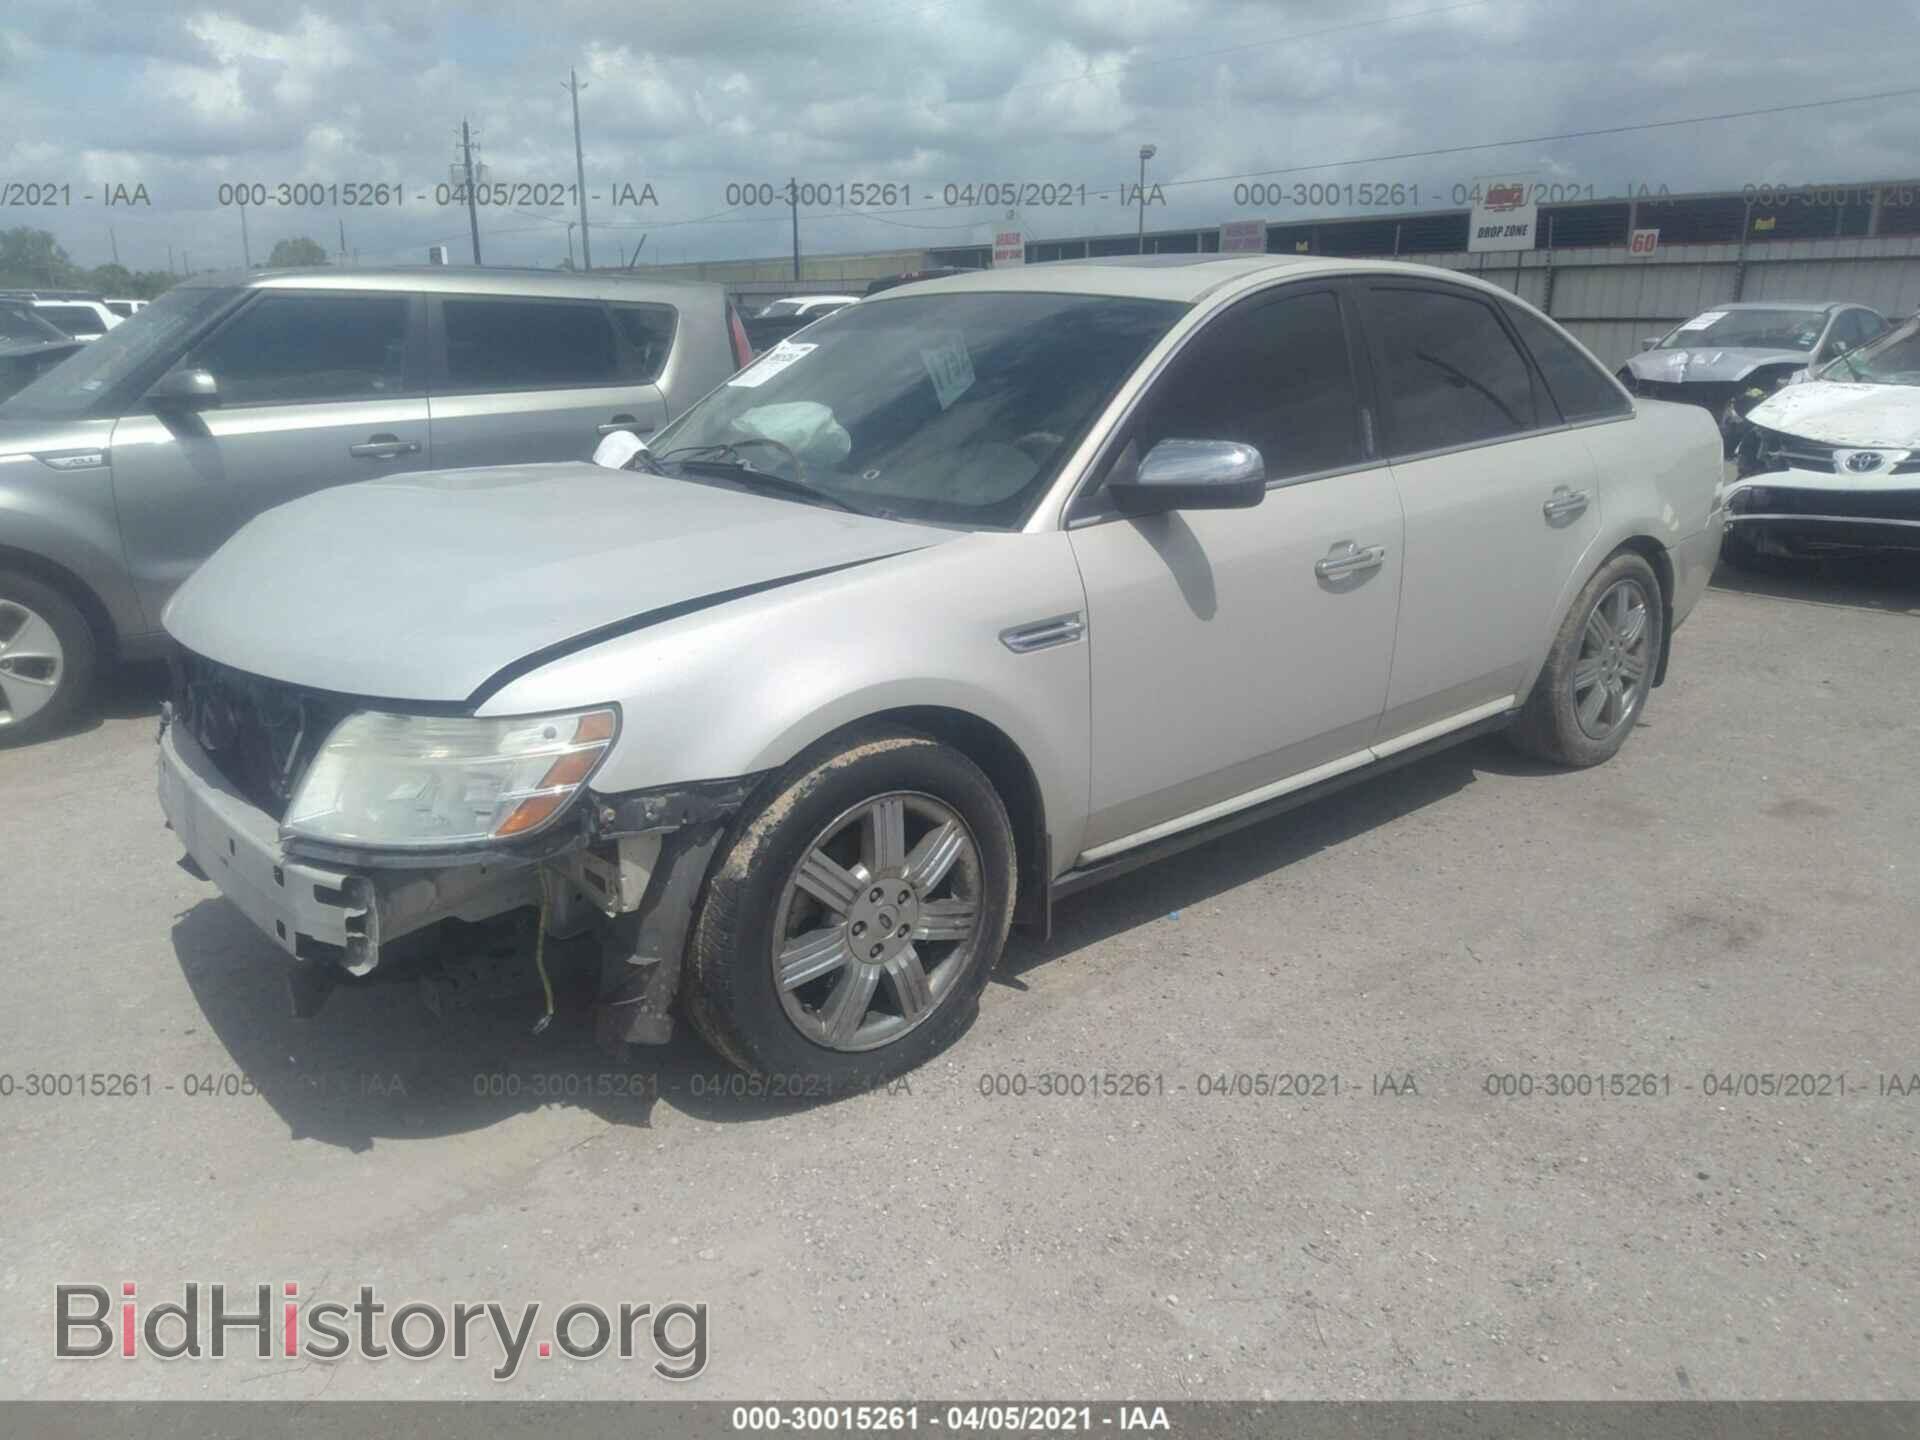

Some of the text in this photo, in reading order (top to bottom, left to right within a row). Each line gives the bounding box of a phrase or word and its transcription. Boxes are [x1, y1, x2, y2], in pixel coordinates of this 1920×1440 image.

[1477, 224, 1529, 239] DROP ZONE
[1632, 233, 1657, 254] 60
